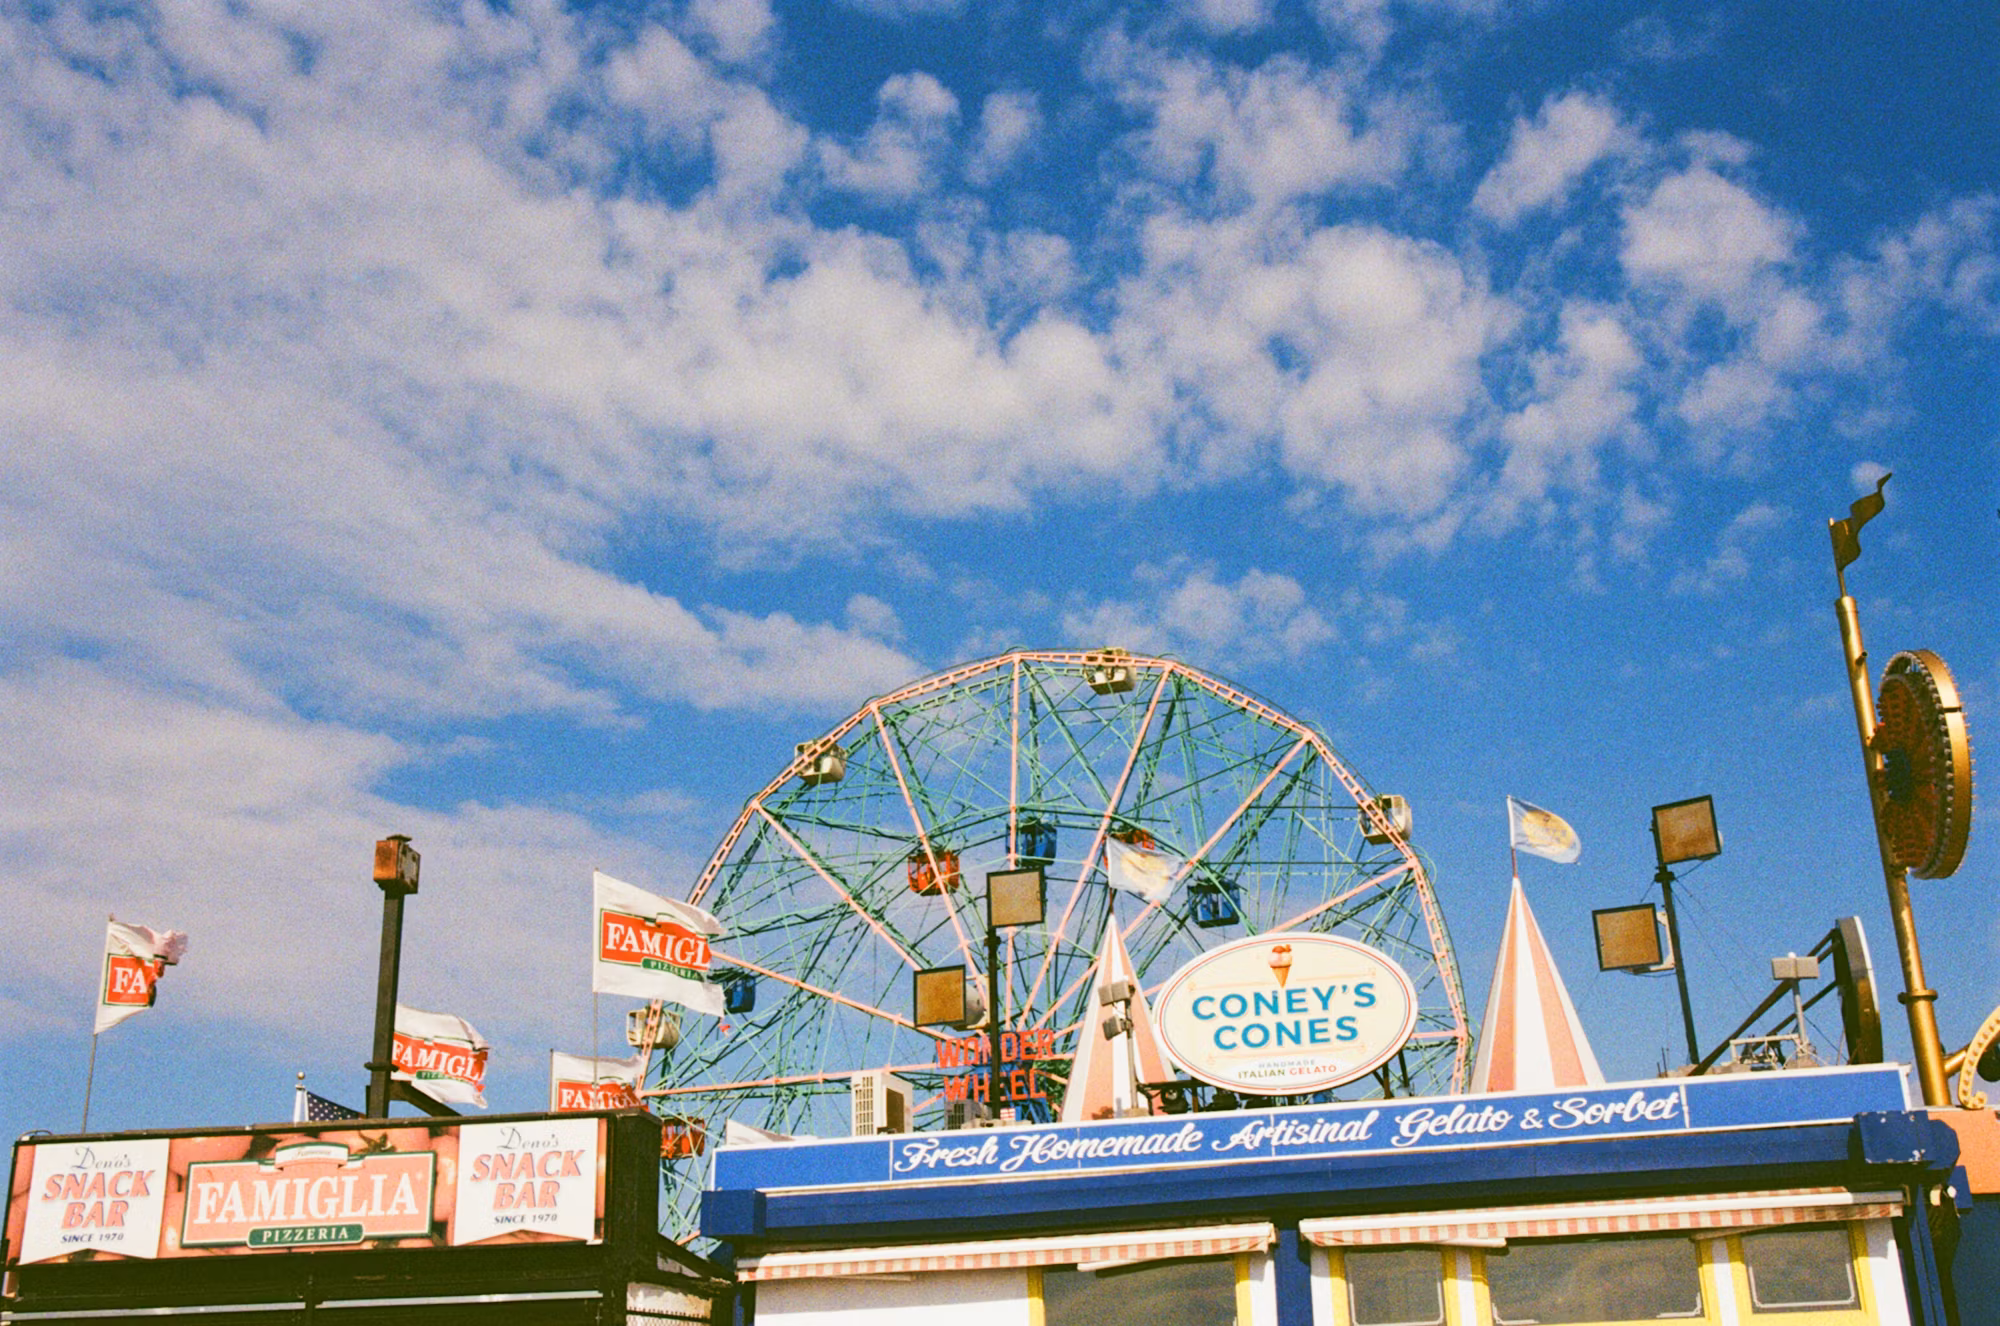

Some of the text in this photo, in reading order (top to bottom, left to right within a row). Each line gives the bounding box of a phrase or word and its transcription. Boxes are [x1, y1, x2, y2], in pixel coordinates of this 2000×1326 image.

[112, 966, 148, 995] FA
[1192, 982, 1377, 1020] CONEY'S
[1213, 1016, 1359, 1050] CONES
[1238, 1064, 1337, 1079] ITALIAN GELATO
[1258, 1059, 1315, 1068] HANDMADE
[497, 1127, 559, 1149] Deno's
[894, 1091, 1681, 1172] Fresh Homemade Artisinal Gelato & Sorbet
[71, 1146, 131, 1169] Deno's
[470, 1150, 586, 1182] SNACK
[41, 1170, 156, 1201] SNACK
[193, 1173, 419, 1224] FAMIGLIA
[493, 1181, 560, 1210] BAR
[61, 1201, 129, 1229] BAR
[494, 1213, 558, 1225] SINCE 1970
[61, 1232, 124, 1244] SINCE 1970
[262, 1226, 350, 1243] PIZZERIA
